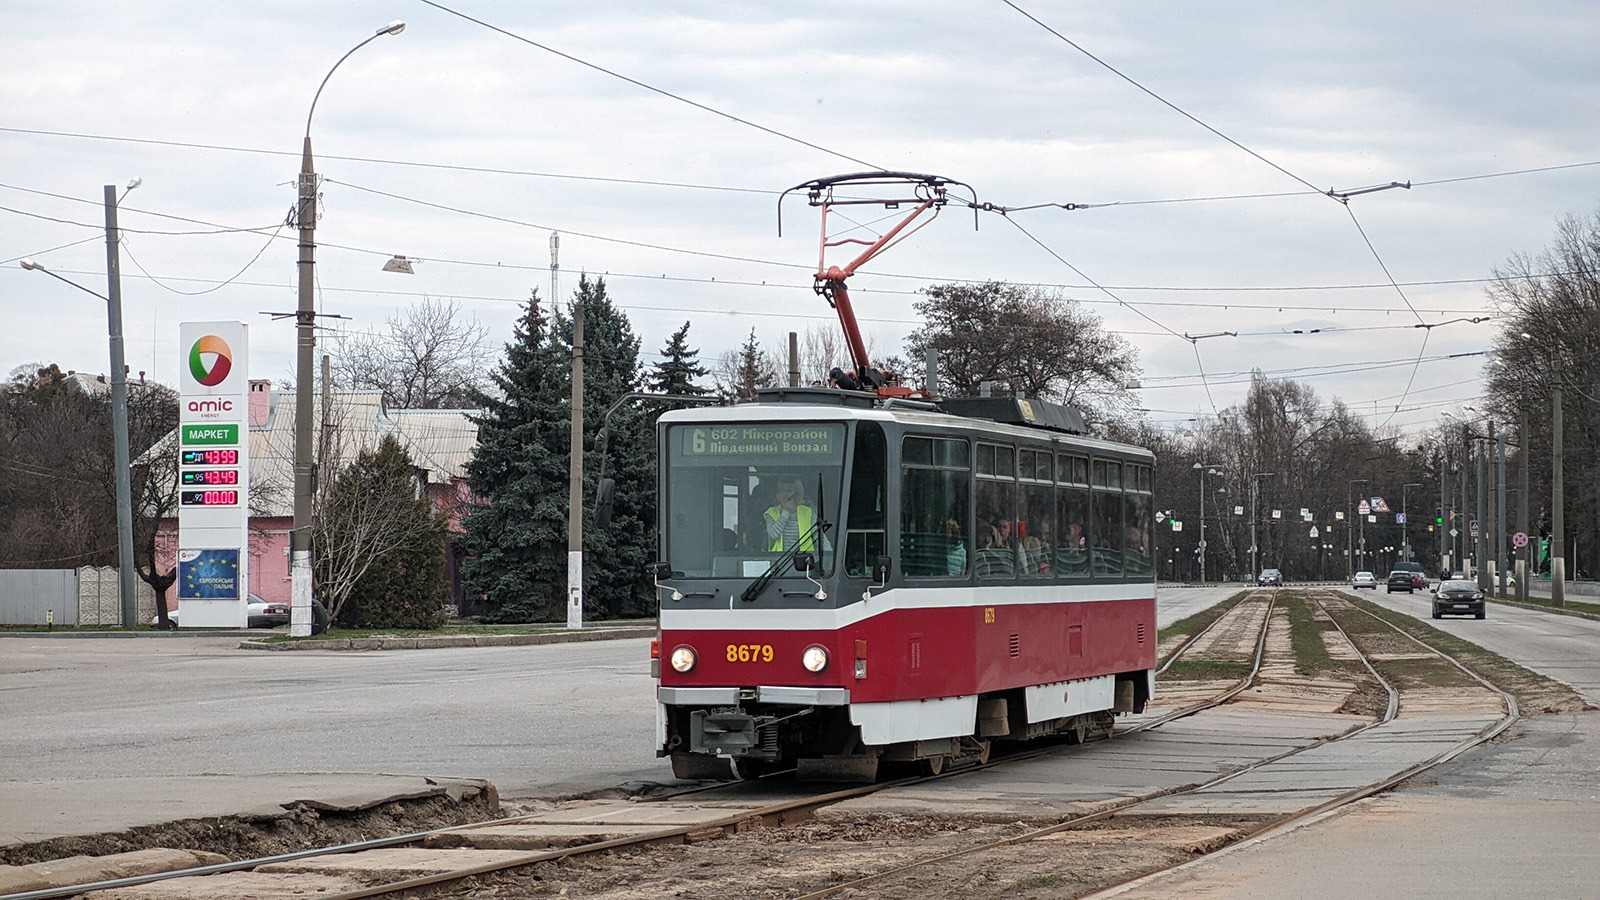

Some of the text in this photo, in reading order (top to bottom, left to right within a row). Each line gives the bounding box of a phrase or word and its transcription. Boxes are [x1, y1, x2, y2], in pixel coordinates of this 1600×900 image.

[188, 397, 233, 412] amic
[189, 429, 230, 440] МАРКЕТ
[692, 428, 706, 453] 6
[711, 428, 828, 441] 602 Мікрорайон
[710, 441, 828, 453] Південний Вокзал
[205, 471, 236, 484] 43.49
[204, 491, 236, 504] 00.00
[984, 607, 995, 624] 8679
[726, 644, 774, 663] 8679
